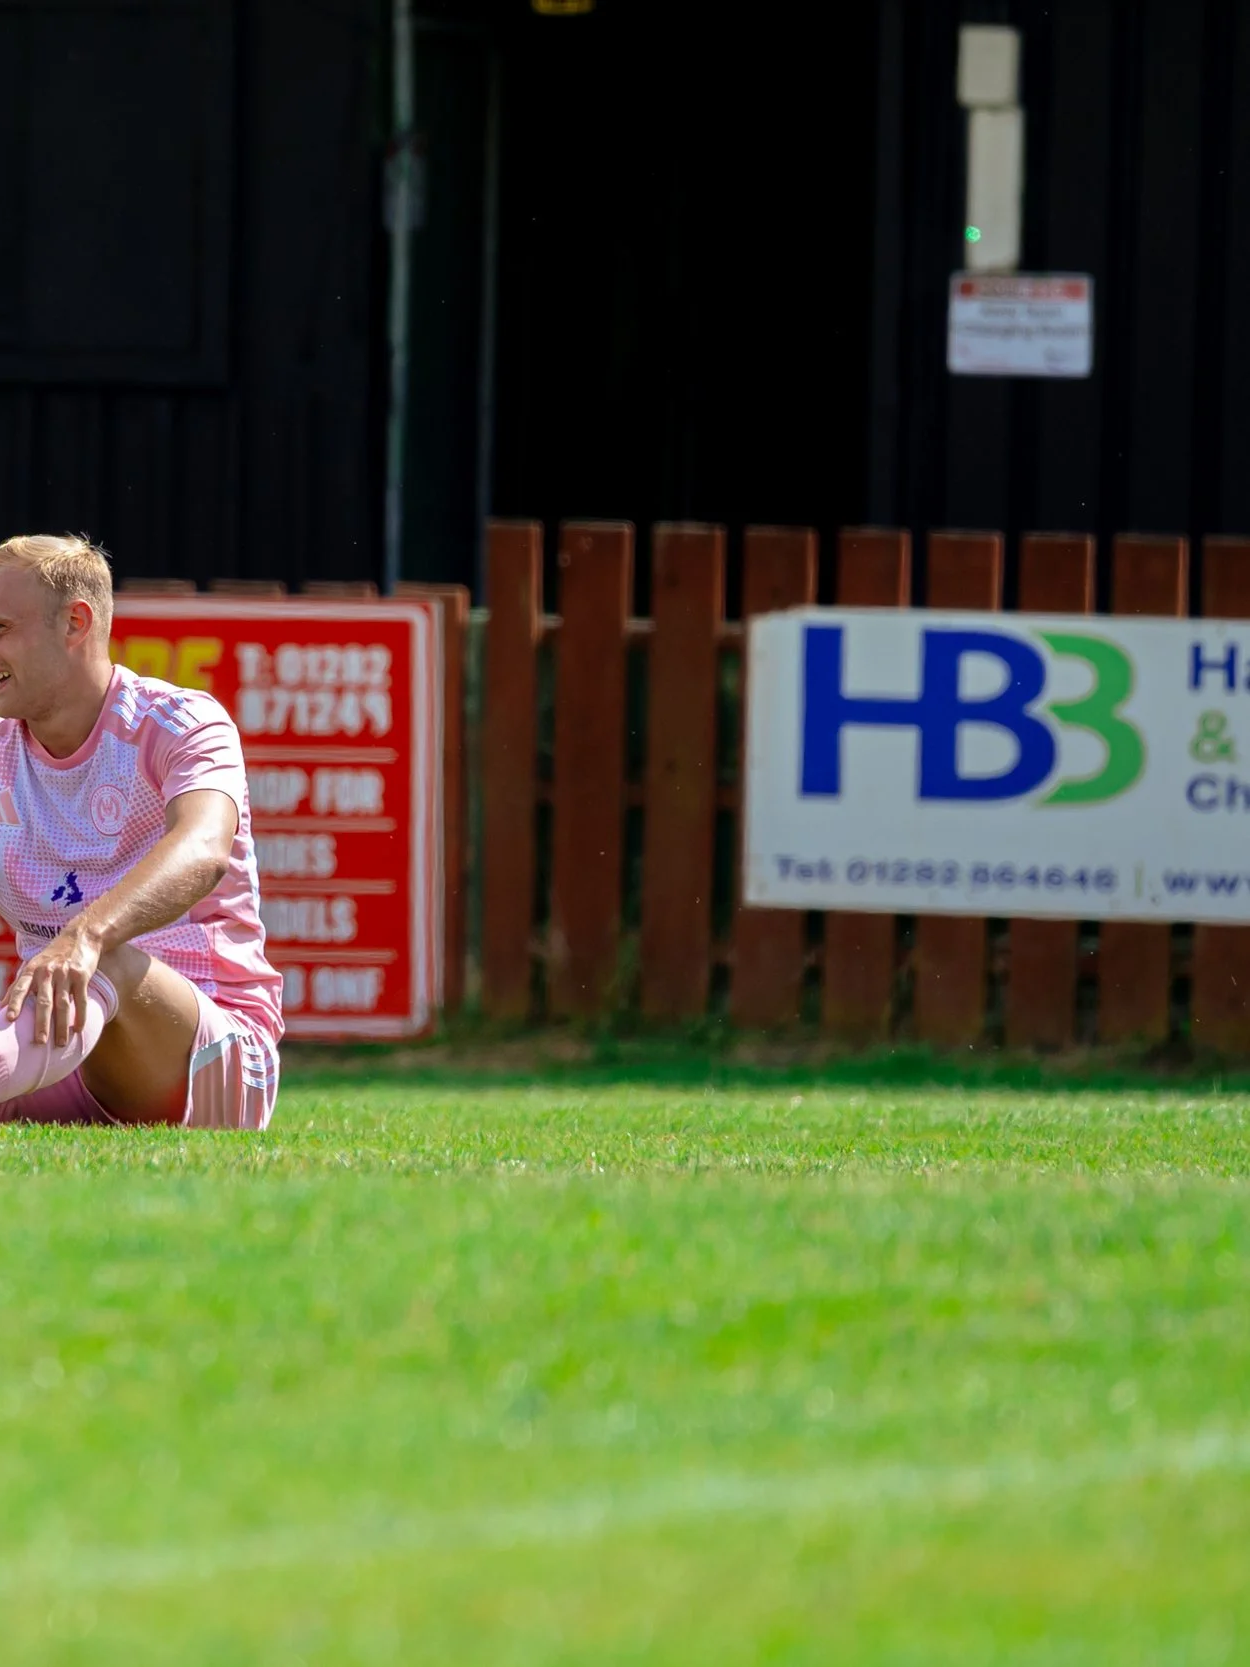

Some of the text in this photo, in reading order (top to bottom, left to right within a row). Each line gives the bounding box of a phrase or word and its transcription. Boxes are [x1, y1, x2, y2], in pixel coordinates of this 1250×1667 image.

[276, 645, 390, 684] 01282
[1188, 640, 1250, 693] H
[239, 690, 390, 733] 871249
[1190, 708, 1237, 763] &
[313, 771, 383, 812] FOR
